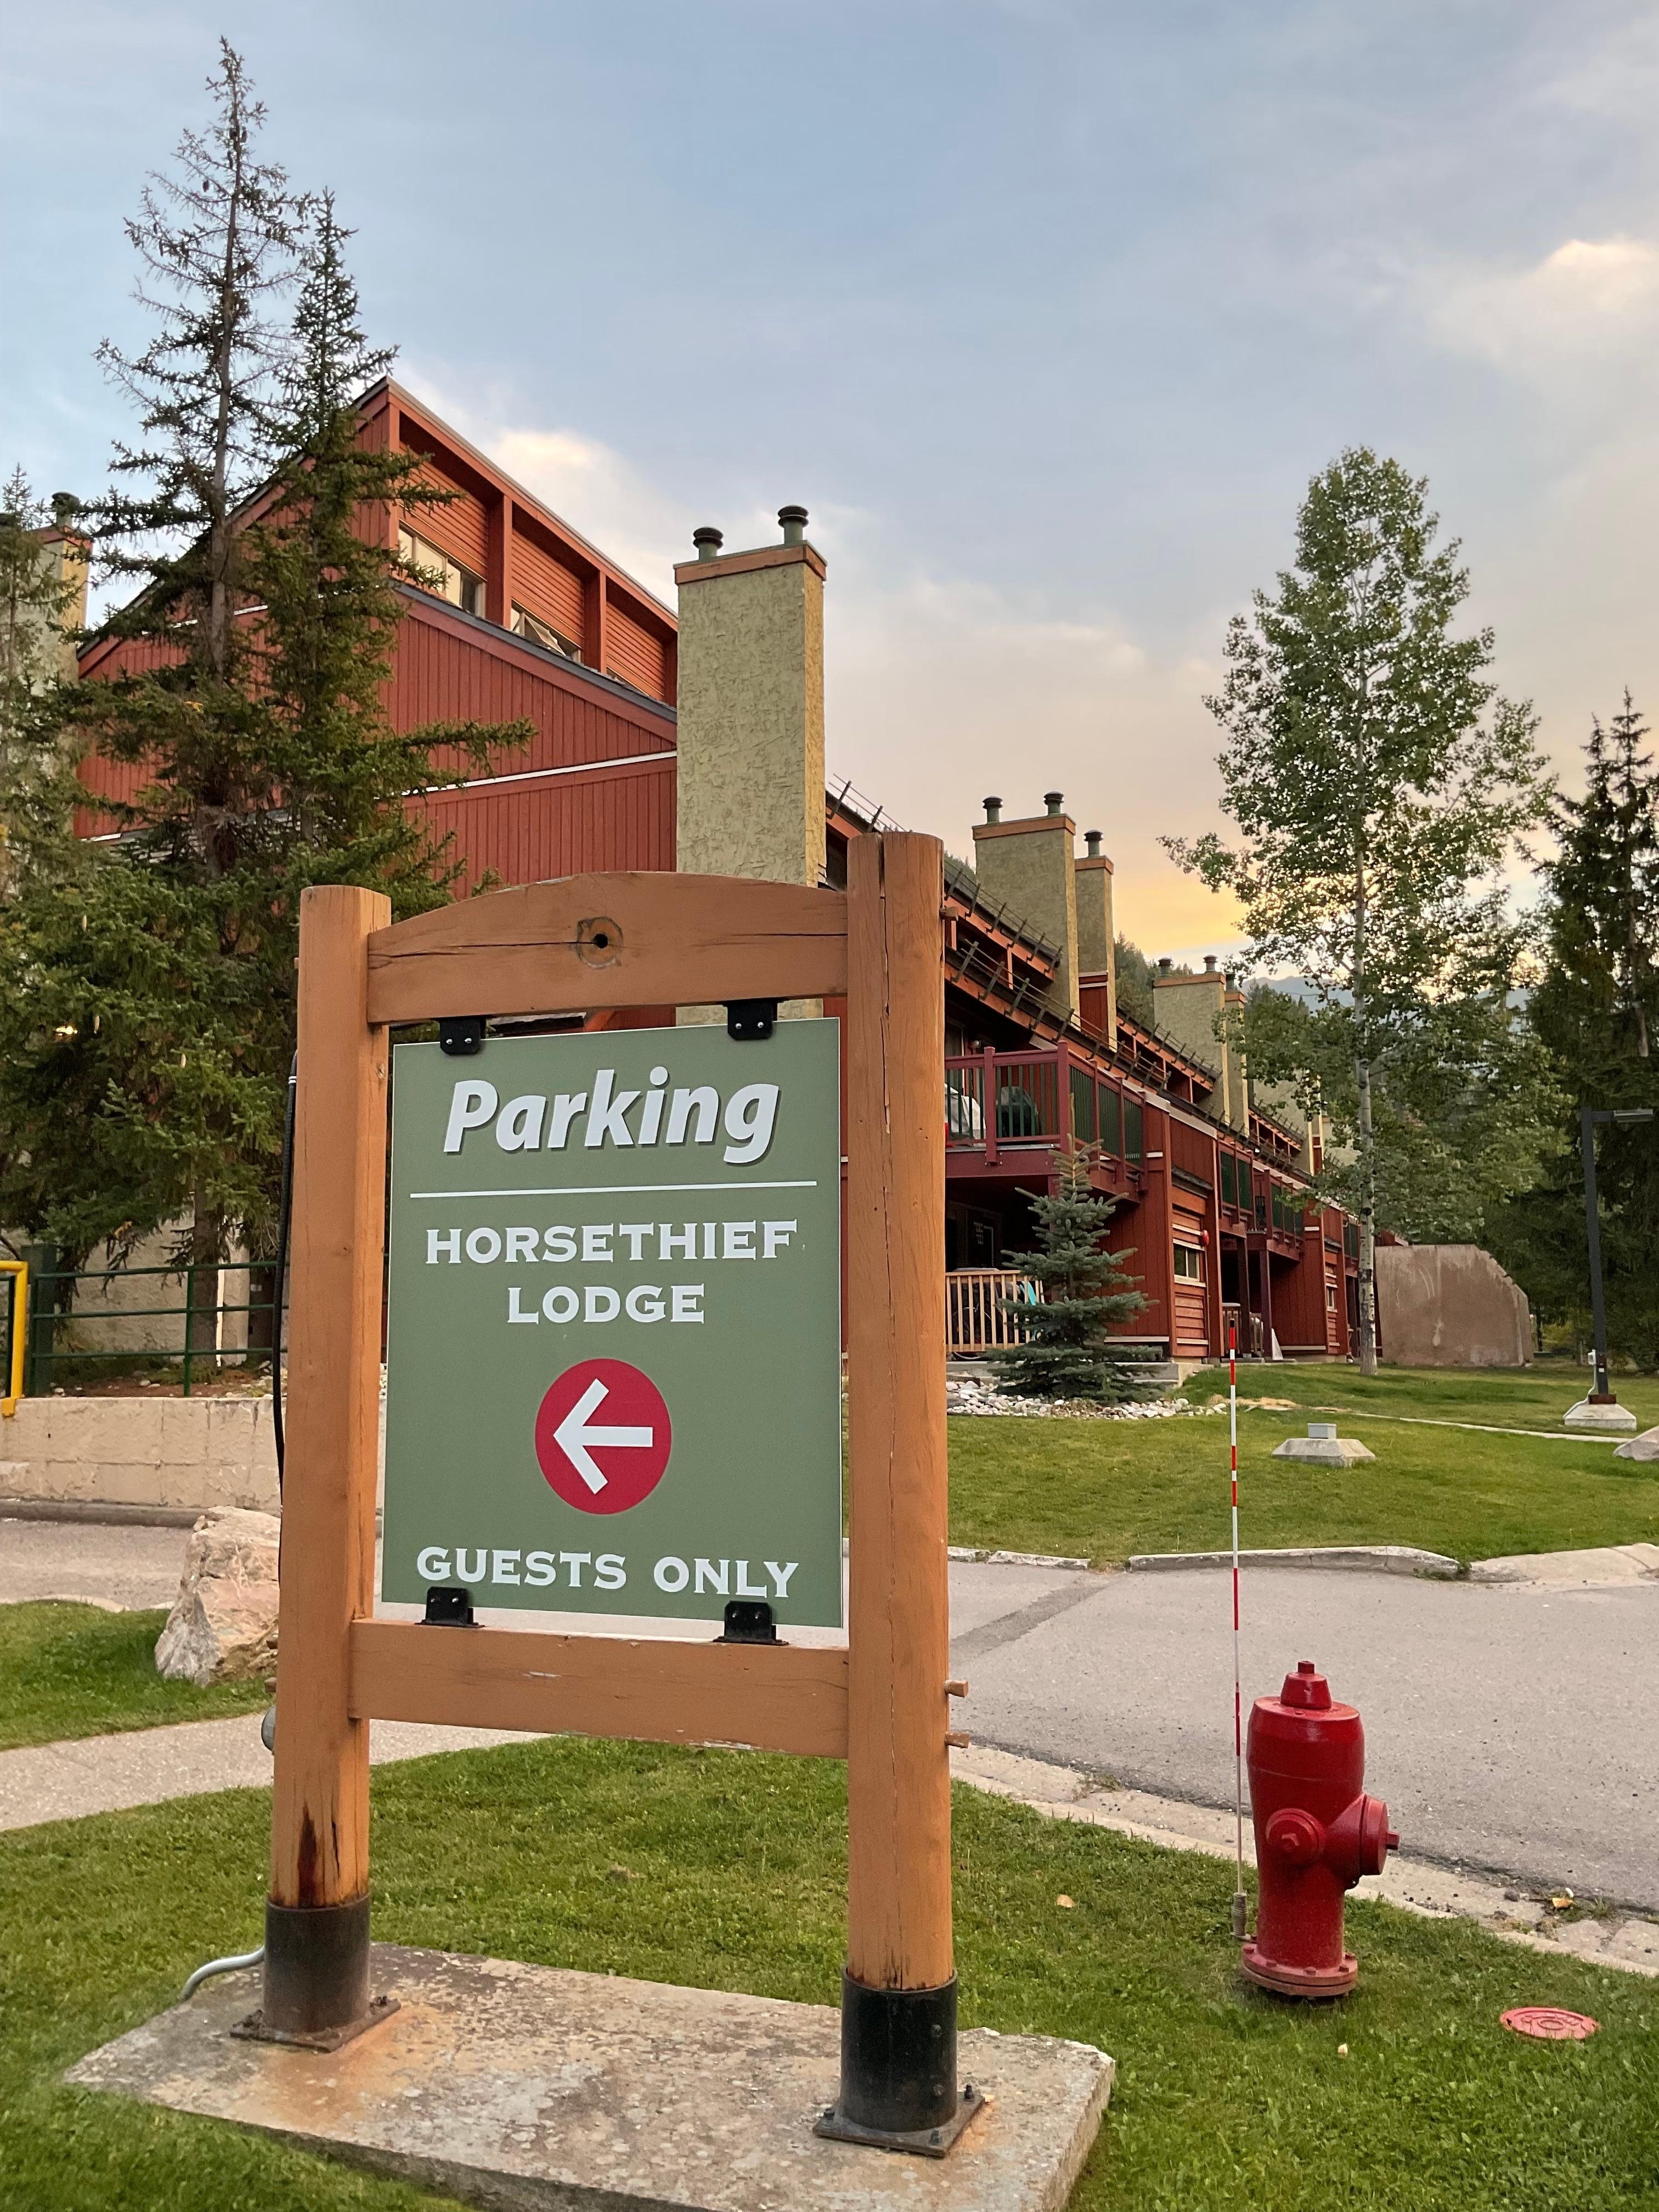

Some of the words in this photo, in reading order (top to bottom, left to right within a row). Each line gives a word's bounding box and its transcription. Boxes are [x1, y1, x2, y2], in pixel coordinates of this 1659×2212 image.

[443, 1066, 780, 1164] Parking
[425, 1218, 798, 1265] HORSETHIEF
[507, 1283, 705, 1325] LODGE
[417, 1546, 627, 1589] GUESTS
[653, 1556, 800, 1599] ONLY
